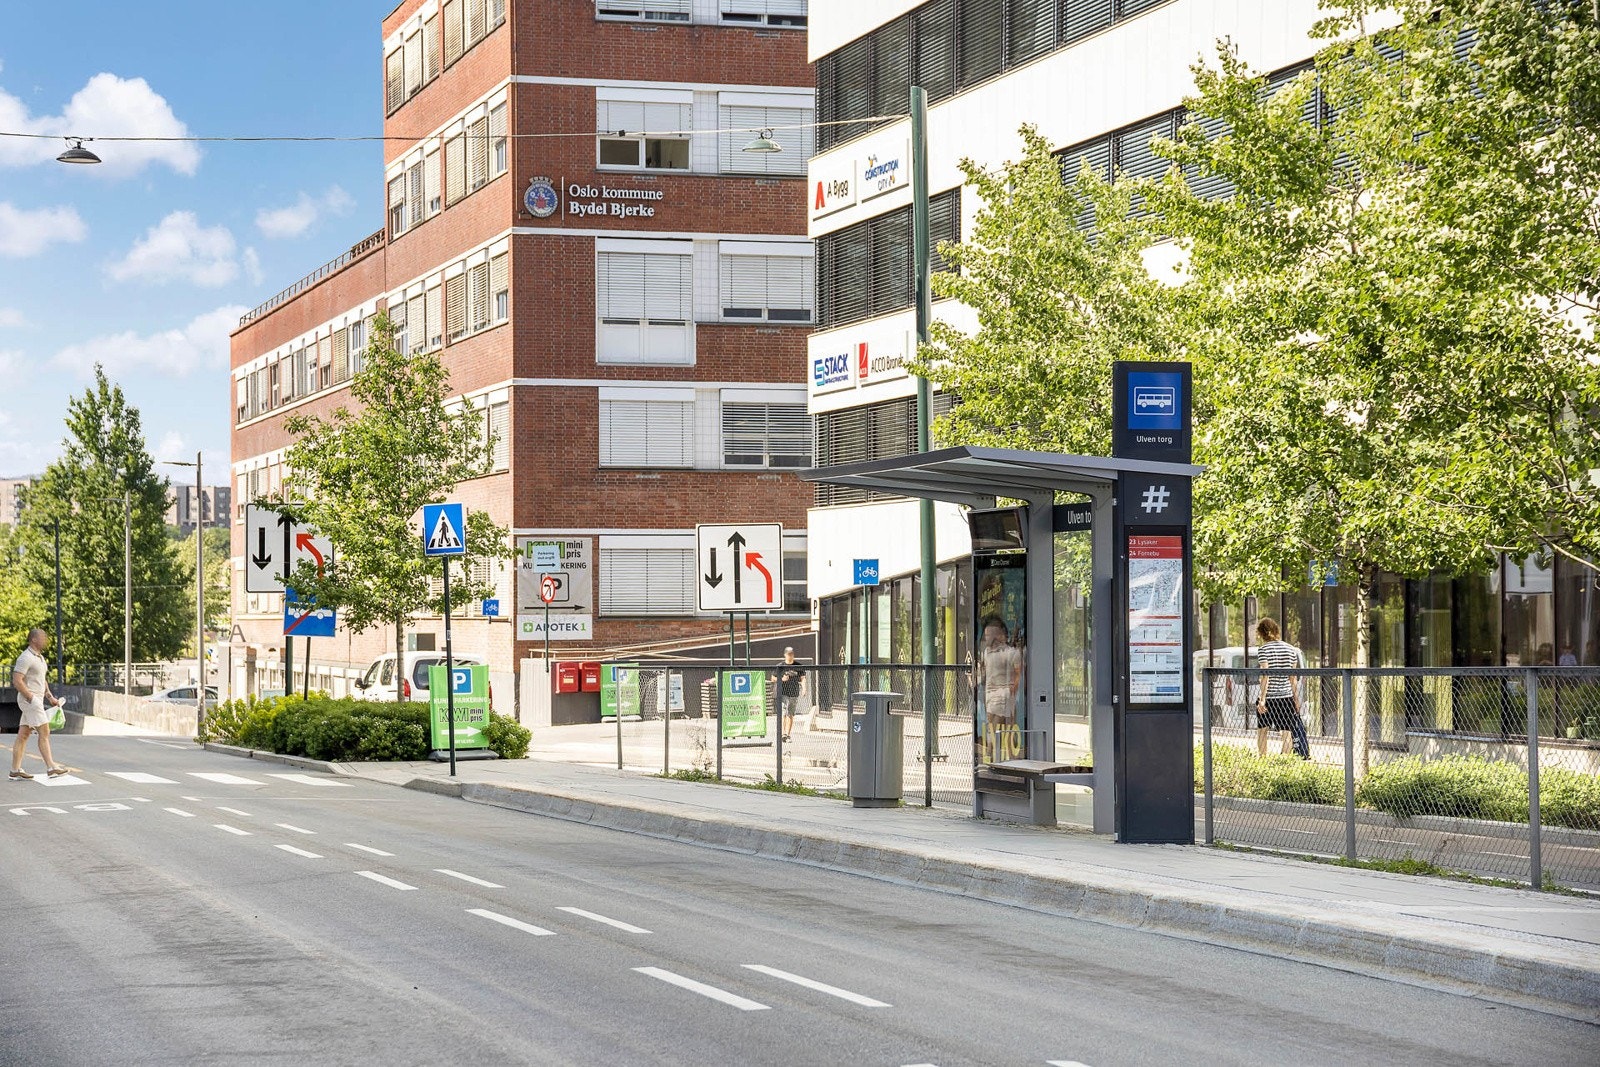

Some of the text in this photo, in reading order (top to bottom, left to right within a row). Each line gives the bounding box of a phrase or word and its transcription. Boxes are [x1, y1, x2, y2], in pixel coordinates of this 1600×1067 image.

[865, 158, 899, 180] CONSTRUCTION
[569, 184, 664, 200] Oslo kommune
[827, 179, 849, 199] A Bygg
[569, 201, 655, 218] Bydel Bjerke
[824, 353, 849, 376] STACK
[870, 356, 886, 373] ACCO
[1136, 435, 1173, 444] Ulven torg
[1067, 510, 1085, 524] Ulven
[566, 540, 583, 549] mini
[1137, 538, 1158, 546] Lysaker
[566, 549, 581, 559] pris
[229, 624, 246, 643] A
[535, 622, 586, 632] APOTEK 1
[452, 672, 467, 691] P
[734, 676, 747, 691] P
[439, 707, 484, 723] KWI mini
[469, 715, 483, 723] pris
